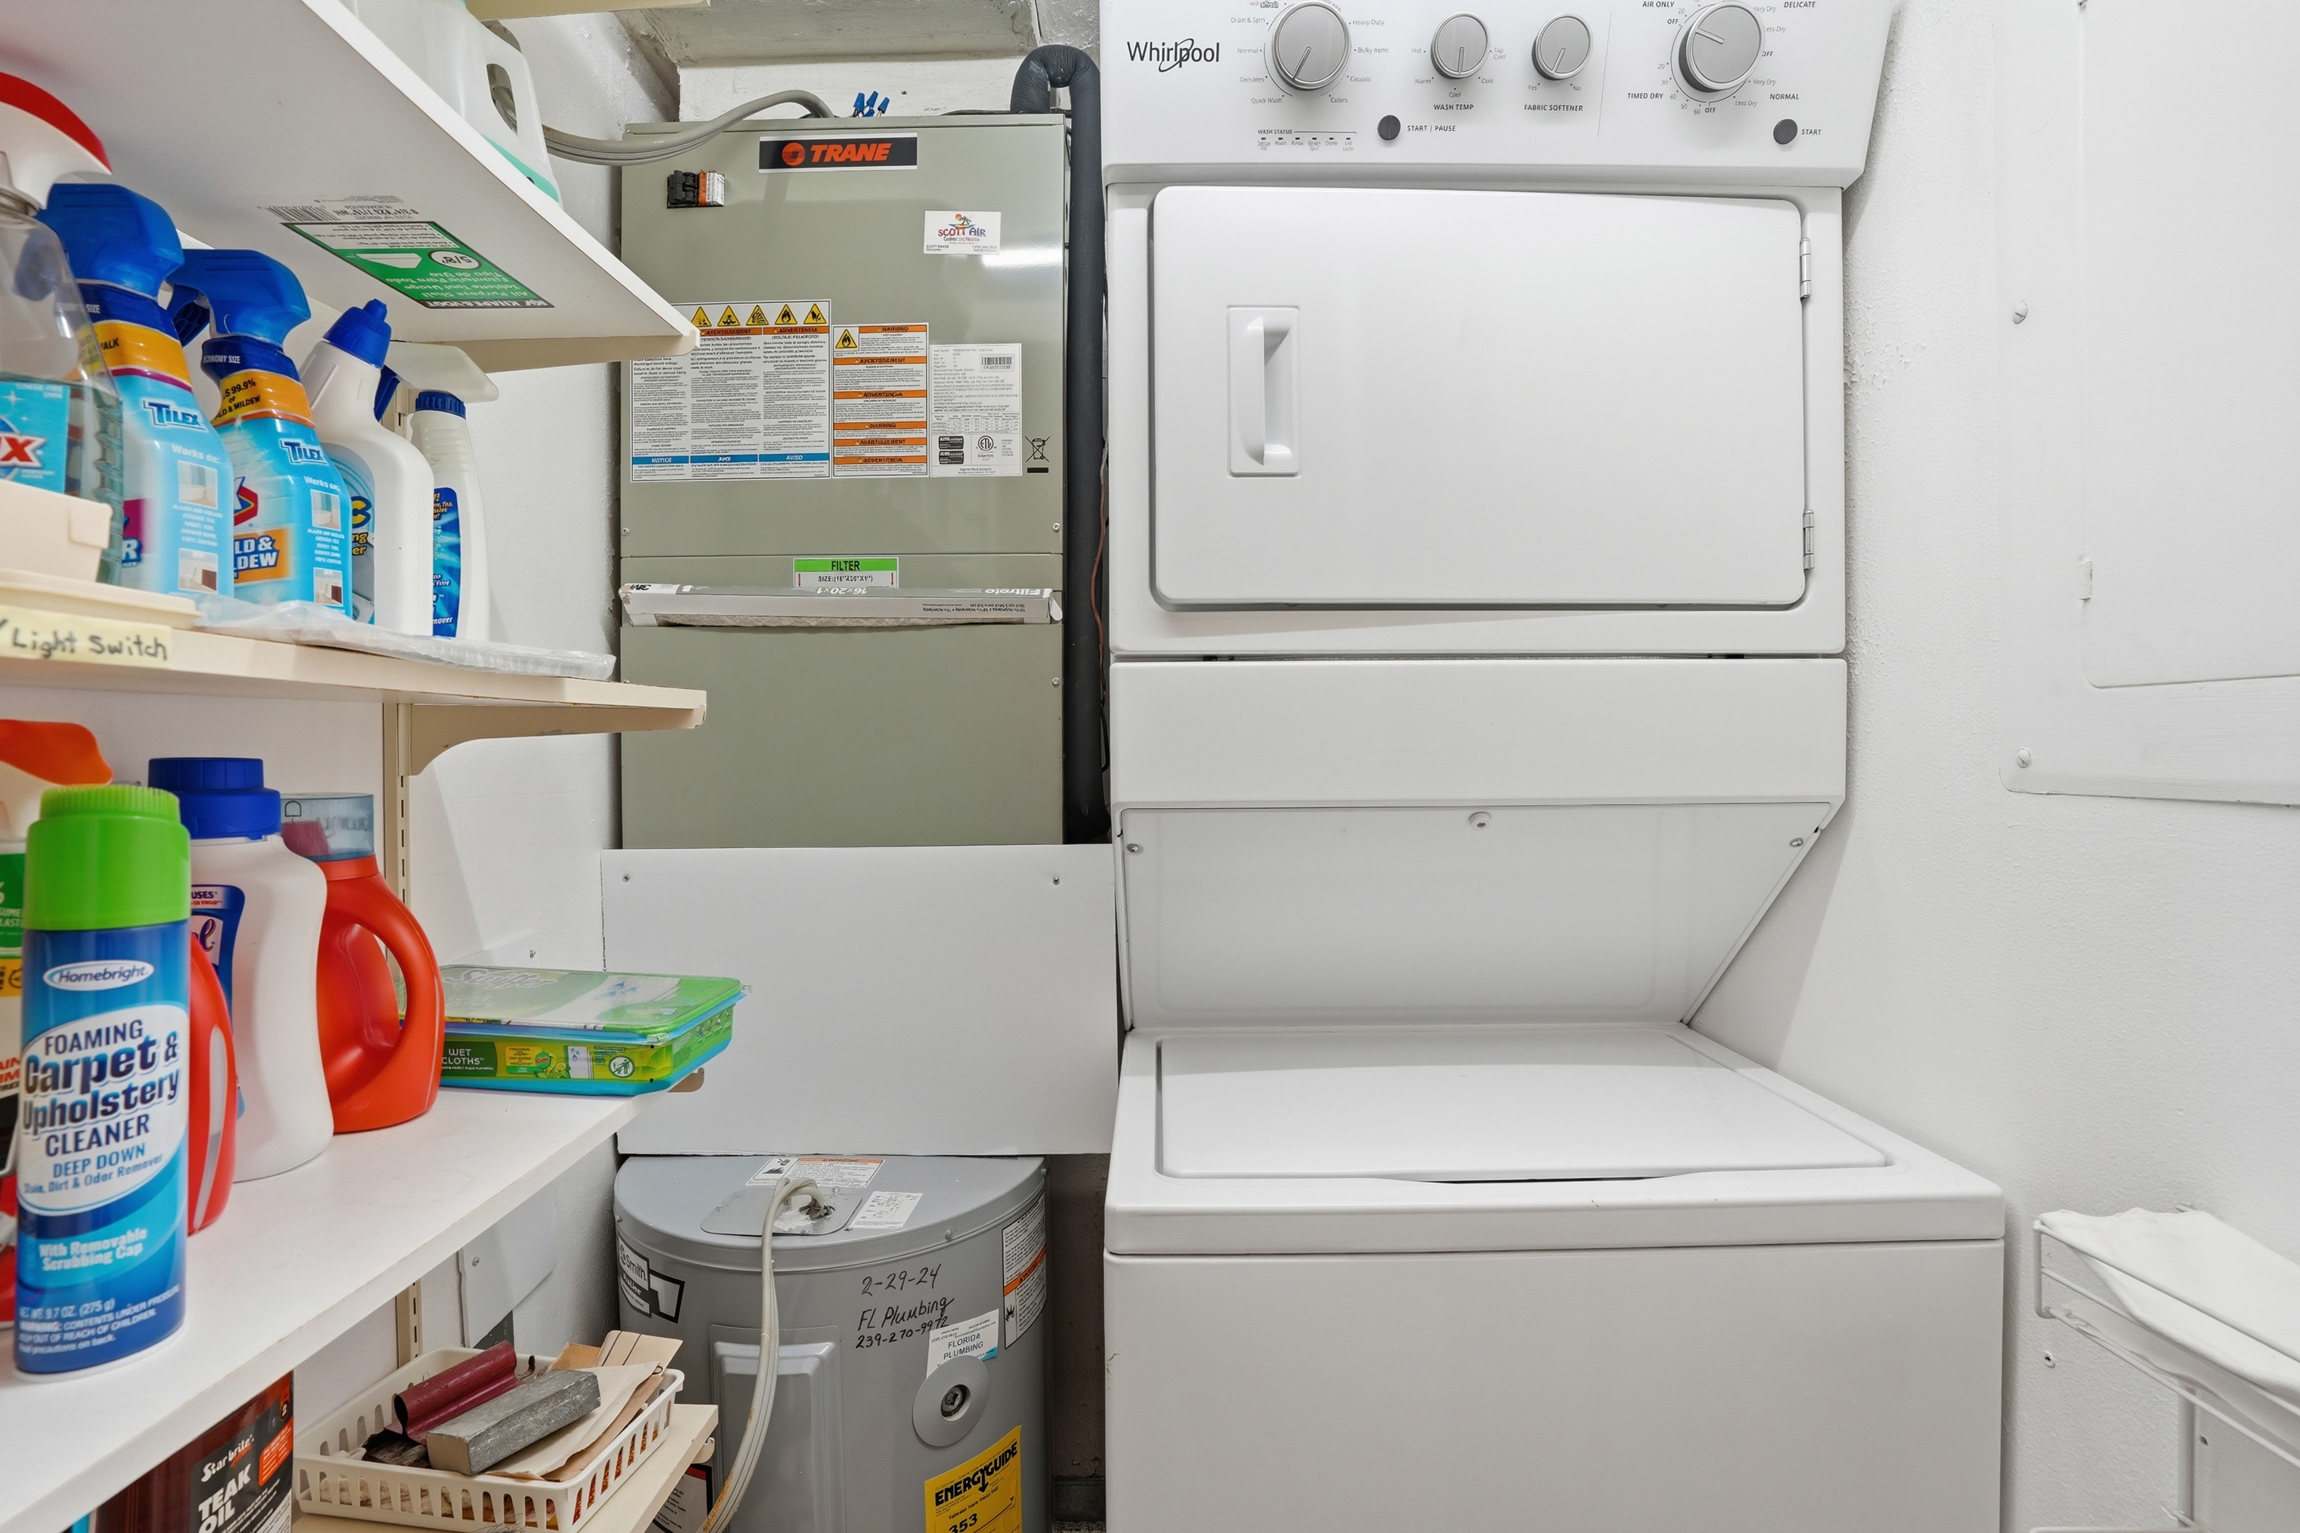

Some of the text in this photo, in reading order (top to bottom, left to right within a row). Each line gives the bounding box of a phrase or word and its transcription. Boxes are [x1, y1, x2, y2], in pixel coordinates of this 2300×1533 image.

[1127, 38, 1220, 72] Whirlpool
[1627, 92, 1664, 100] TIMED DRY
[1433, 103, 1475, 111] WASH TEMP
[1548, 104, 1584, 112] SOFTENER
[1801, 128, 1822, 136] START
[810, 142, 893, 163] TRANE
[938, 227, 987, 237] SCOTT AIR
[231, 378, 257, 394] 99.9%
[234, 394, 260, 411] MILDEW
[258, 536, 273, 551] &
[235, 551, 278, 571] DEW
[831, 560, 860, 571] FILTER
[12, 627, 168, 661] Light Switch
[58, 965, 146, 983] Homebright
[44, 1019, 143, 1057] FOAMING
[25, 1035, 157, 1095] Carpet
[164, 1030, 179, 1063] &
[441, 1057, 481, 1066] CLOTHS
[448, 1048, 472, 1057] WET
[22, 1068, 180, 1137] Upholstery
[45, 1113, 149, 1158] CLEANER
[53, 1143, 146, 1179] DEEP DOWN
[48, 1179, 69, 1192] Dirt
[72, 1176, 81, 1188] &
[84, 1170, 113, 1187] Odor
[116, 1154, 164, 1177] Remover
[39, 1228, 148, 1258] With Removable
[42, 1242, 144, 1271] Scrubbing Cap
[862, 1263, 942, 1297] 2-29-24
[857, 1306, 878, 1332] FL
[880, 1295, 956, 1330] Plumbing
[63, 1327, 96, 1342] REACH
[855, 1315, 950, 1350] 239-270-9972
[947, 1332, 982, 1350] FLORIDA
[943, 1341, 985, 1361] PLUMBING
[935, 1441, 1018, 1507] ENERGYGUIDE
[198, 1463, 252, 1521] TEAK
[198, 1499, 236, 1533] OIL
